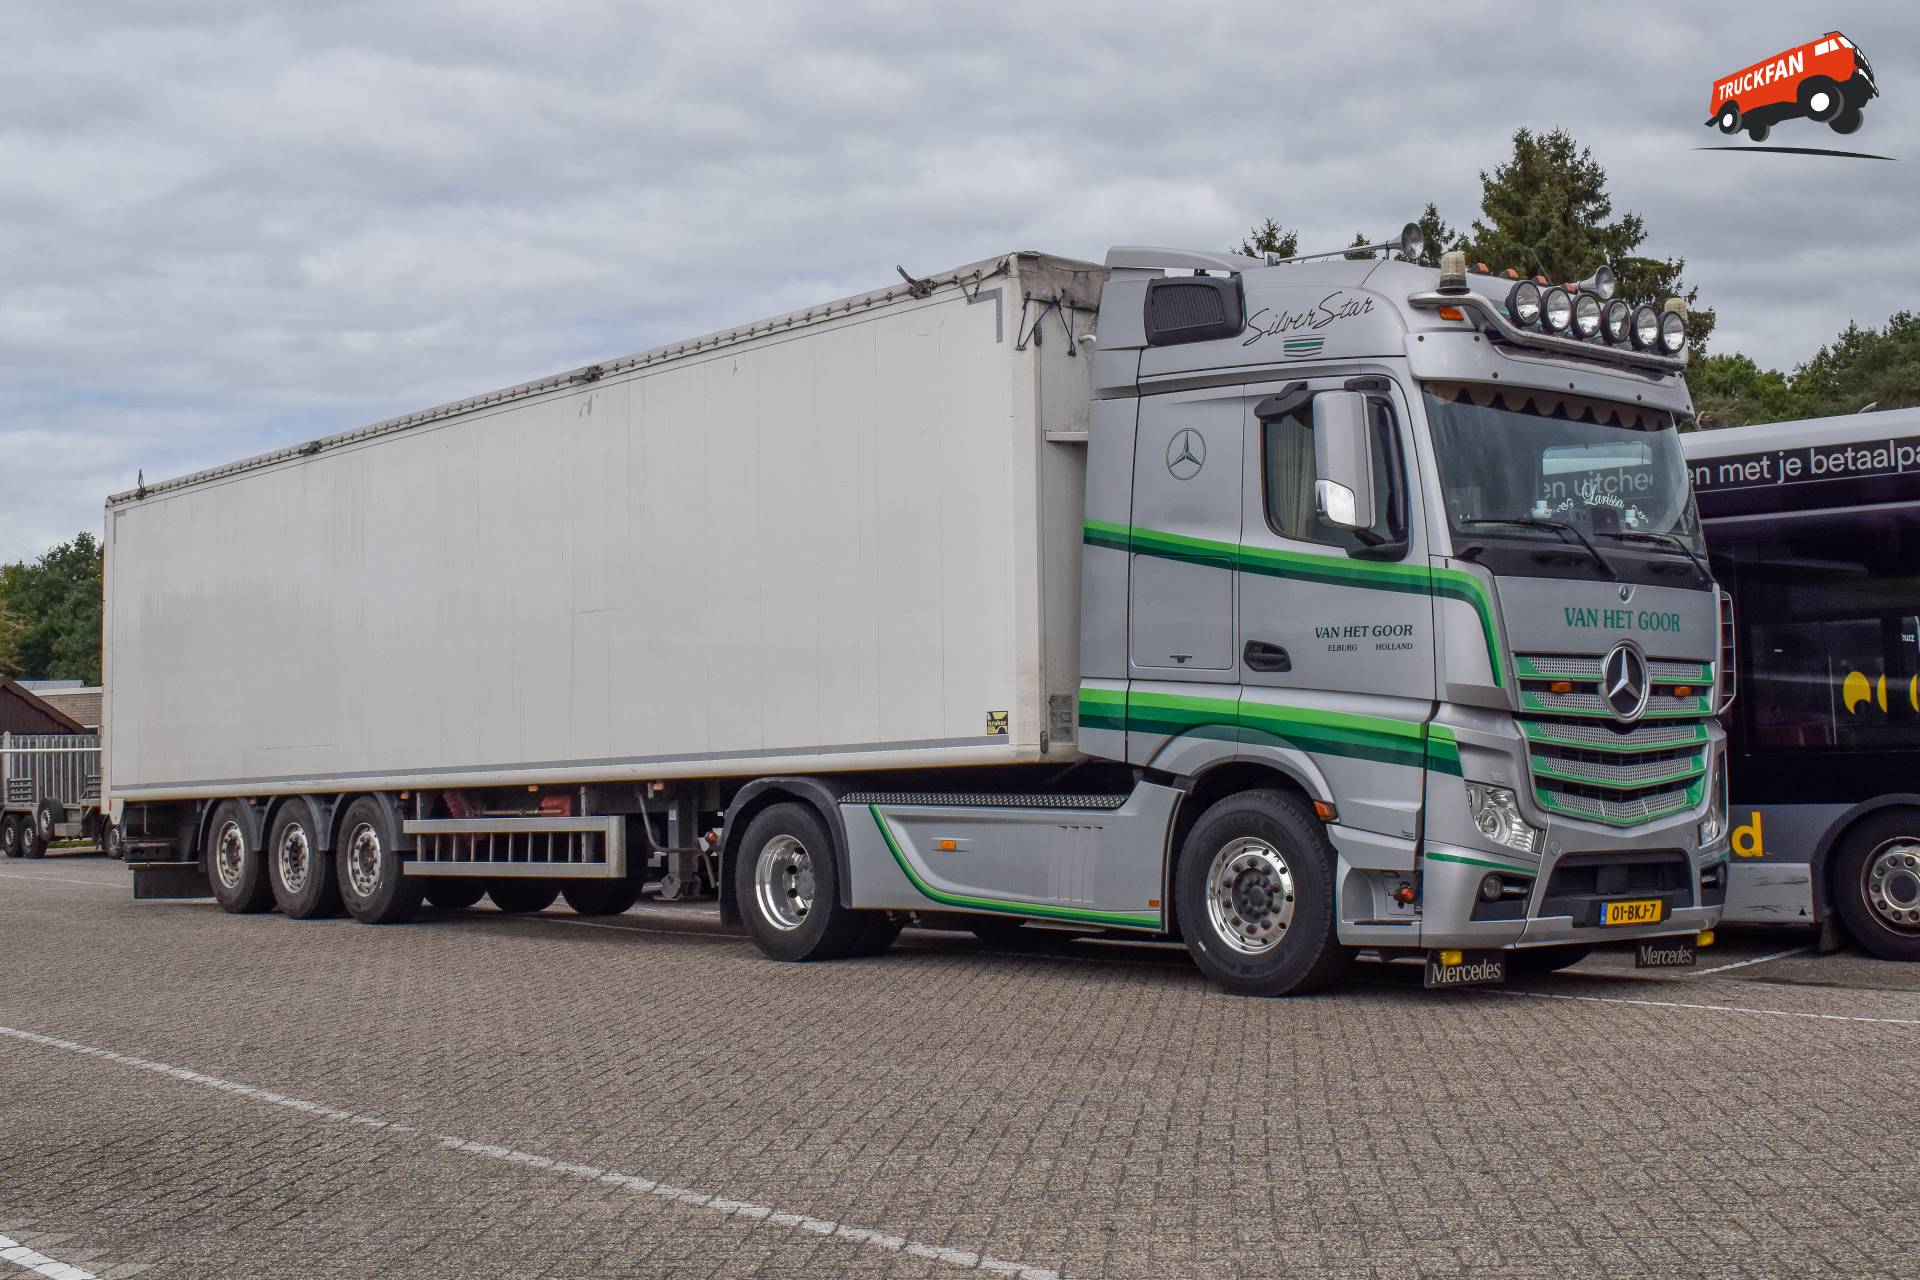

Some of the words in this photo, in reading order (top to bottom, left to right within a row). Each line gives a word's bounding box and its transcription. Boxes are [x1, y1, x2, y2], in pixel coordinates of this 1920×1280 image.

[1719, 455, 1771, 483] met
[1777, 451, 1802, 485] je
[1563, 607, 1599, 628] VAN
[1603, 608, 1634, 630] HET
[1638, 611, 1681, 632] GOOR
[1315, 626, 1340, 639] VAN
[1343, 625, 1369, 638] HET
[1372, 624, 1413, 637] GOOR
[1328, 643, 1358, 652] ELBURG
[1375, 642, 1413, 651] HOLLAND
[1612, 903, 1657, 921] 01-BKJ-7
[1640, 944, 1693, 965] Mercedes
[1430, 959, 1501, 984] Mercedes
